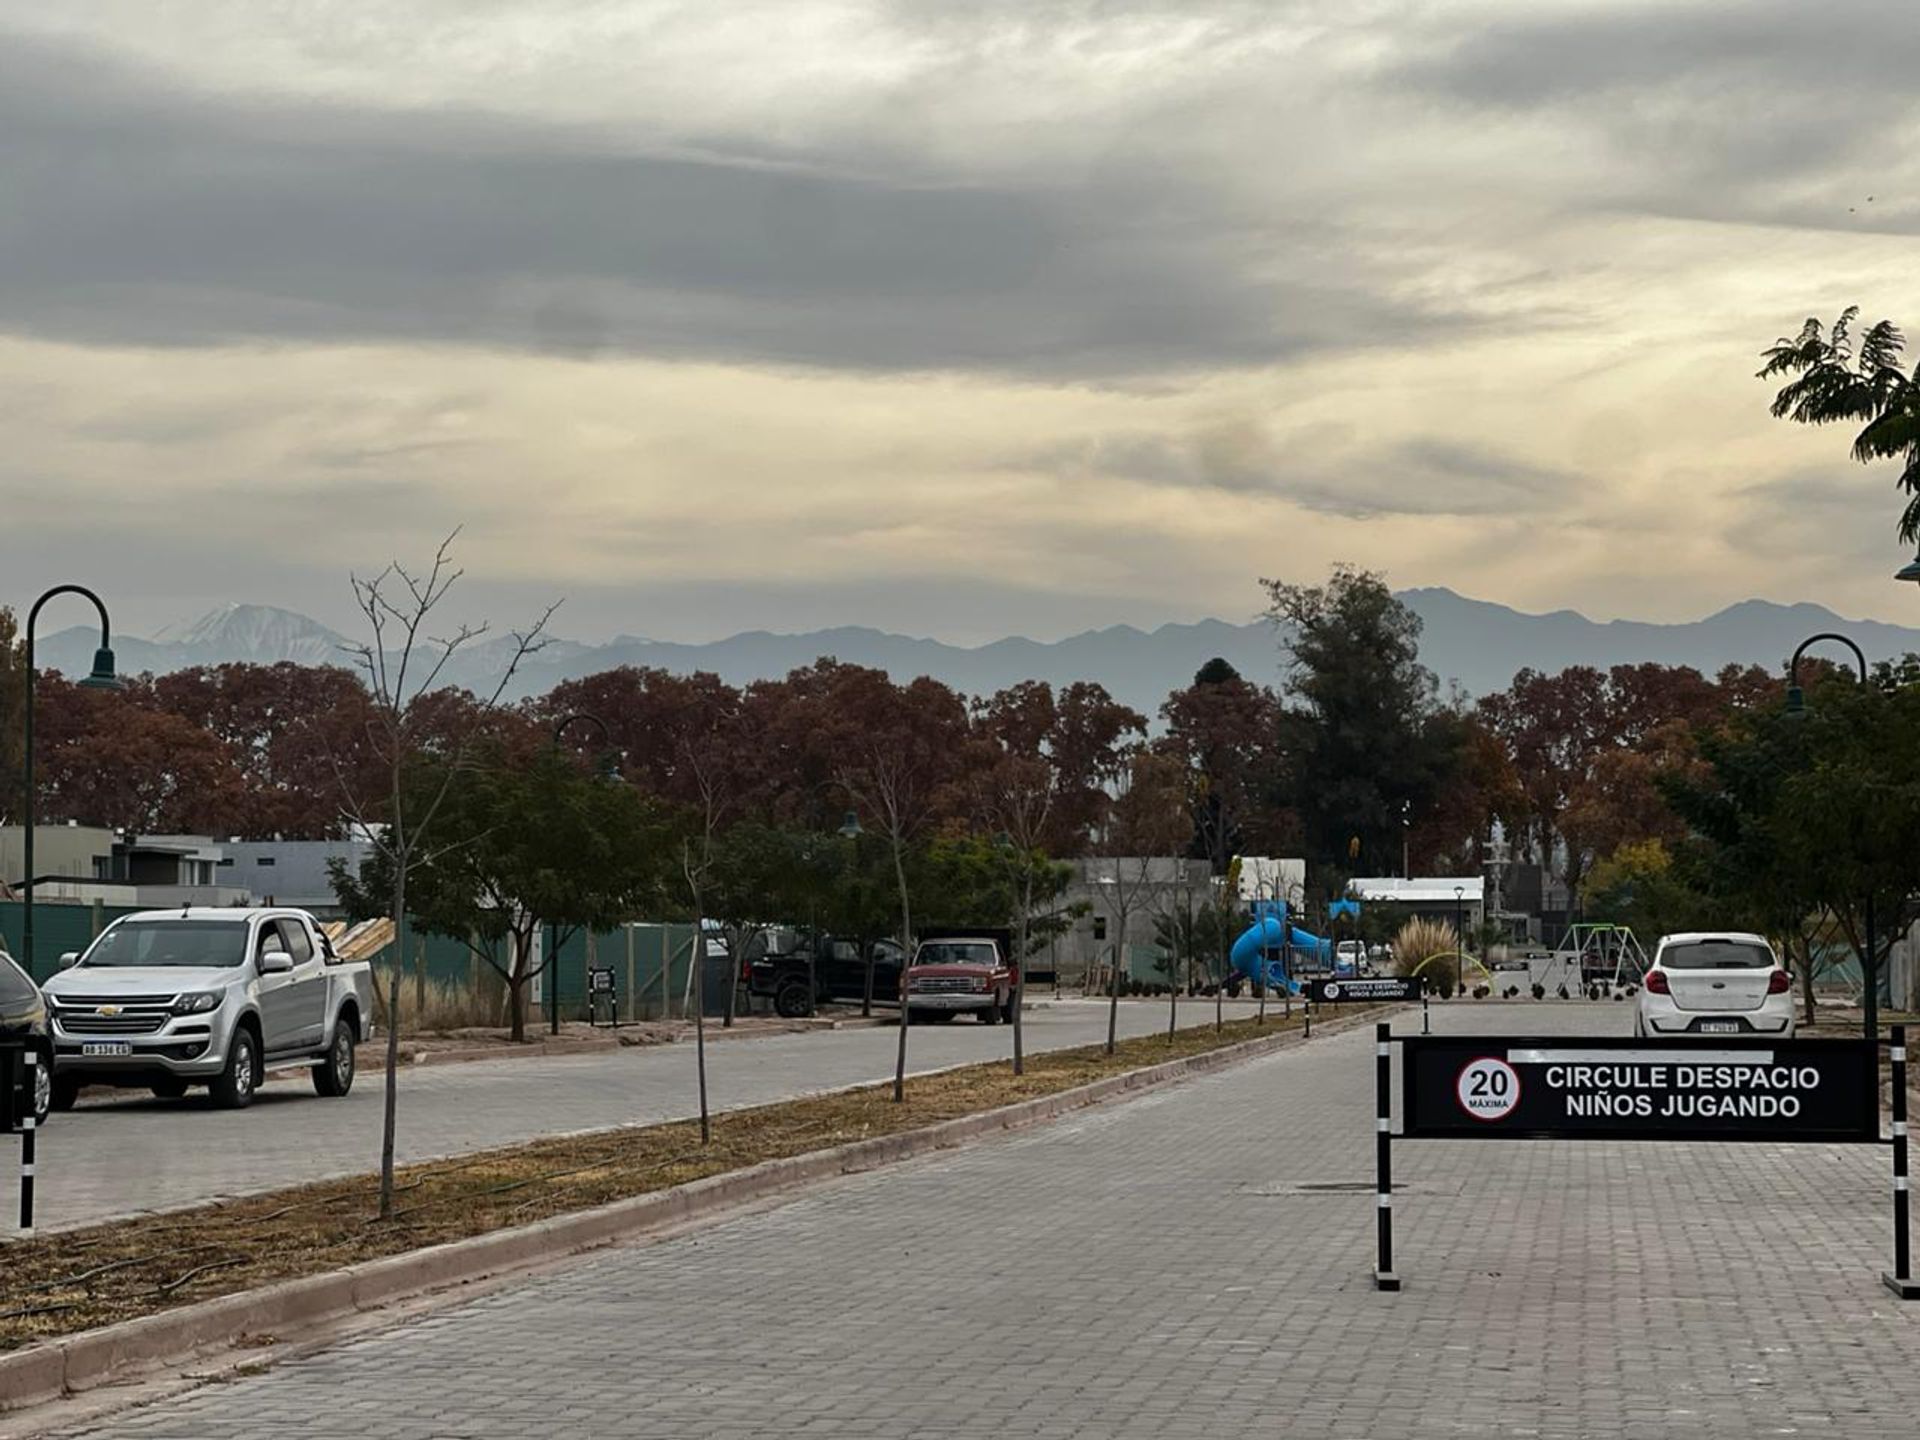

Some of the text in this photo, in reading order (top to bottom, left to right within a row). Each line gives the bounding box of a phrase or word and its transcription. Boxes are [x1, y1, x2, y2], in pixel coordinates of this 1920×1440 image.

[1470, 1070, 1508, 1096] 20
[1546, 1066, 1820, 1089] CIRCULE DESPACIO
[1469, 1098, 1509, 1109] MÁXIMA
[1566, 1090, 1800, 1117] NIÑOS JUGANDO
